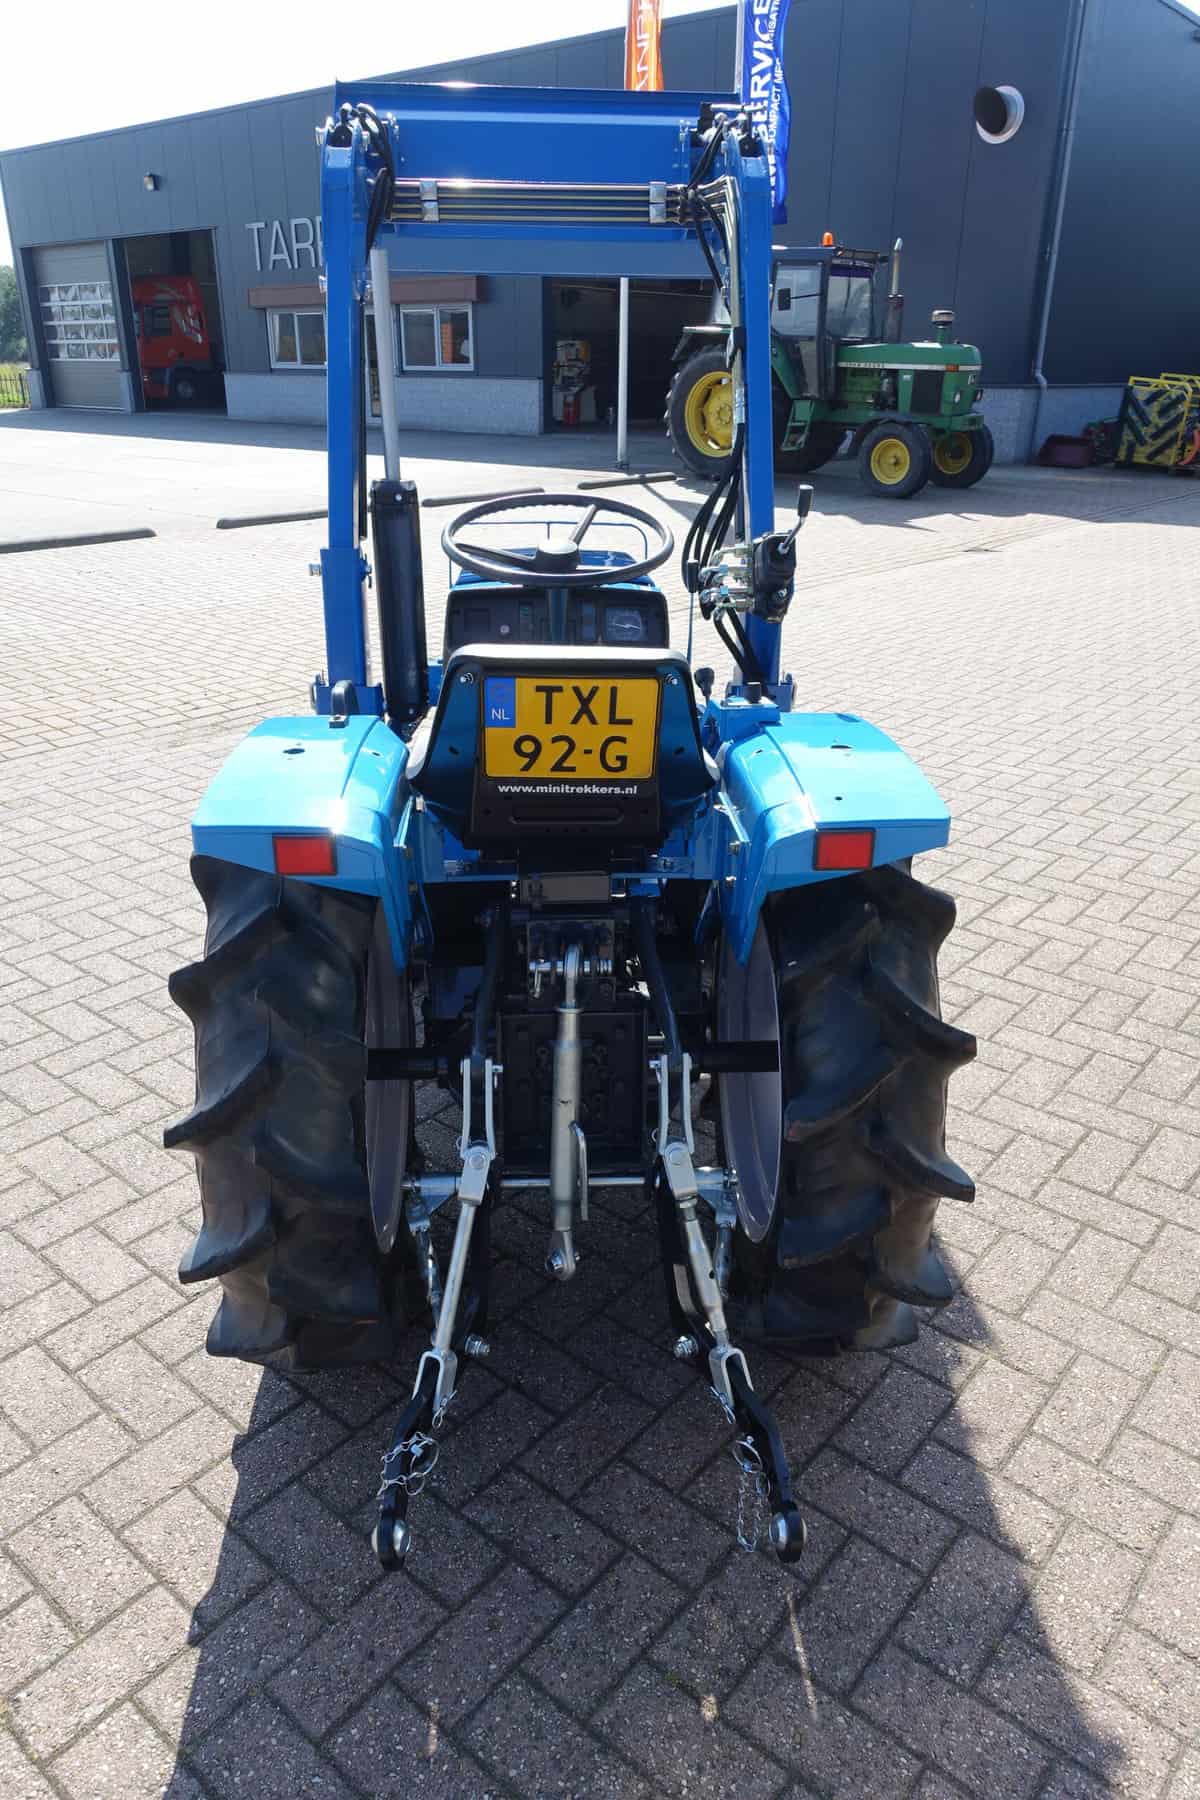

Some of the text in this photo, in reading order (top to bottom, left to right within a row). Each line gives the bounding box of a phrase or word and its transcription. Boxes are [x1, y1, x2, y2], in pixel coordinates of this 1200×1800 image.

[751, 0, 774, 142] SERVICE
[491, 708, 510, 720] NL
[534, 685, 633, 725] TXL
[513, 734, 628, 773] 92-G
[498, 784, 638, 795] www.minitrekkers.nl
